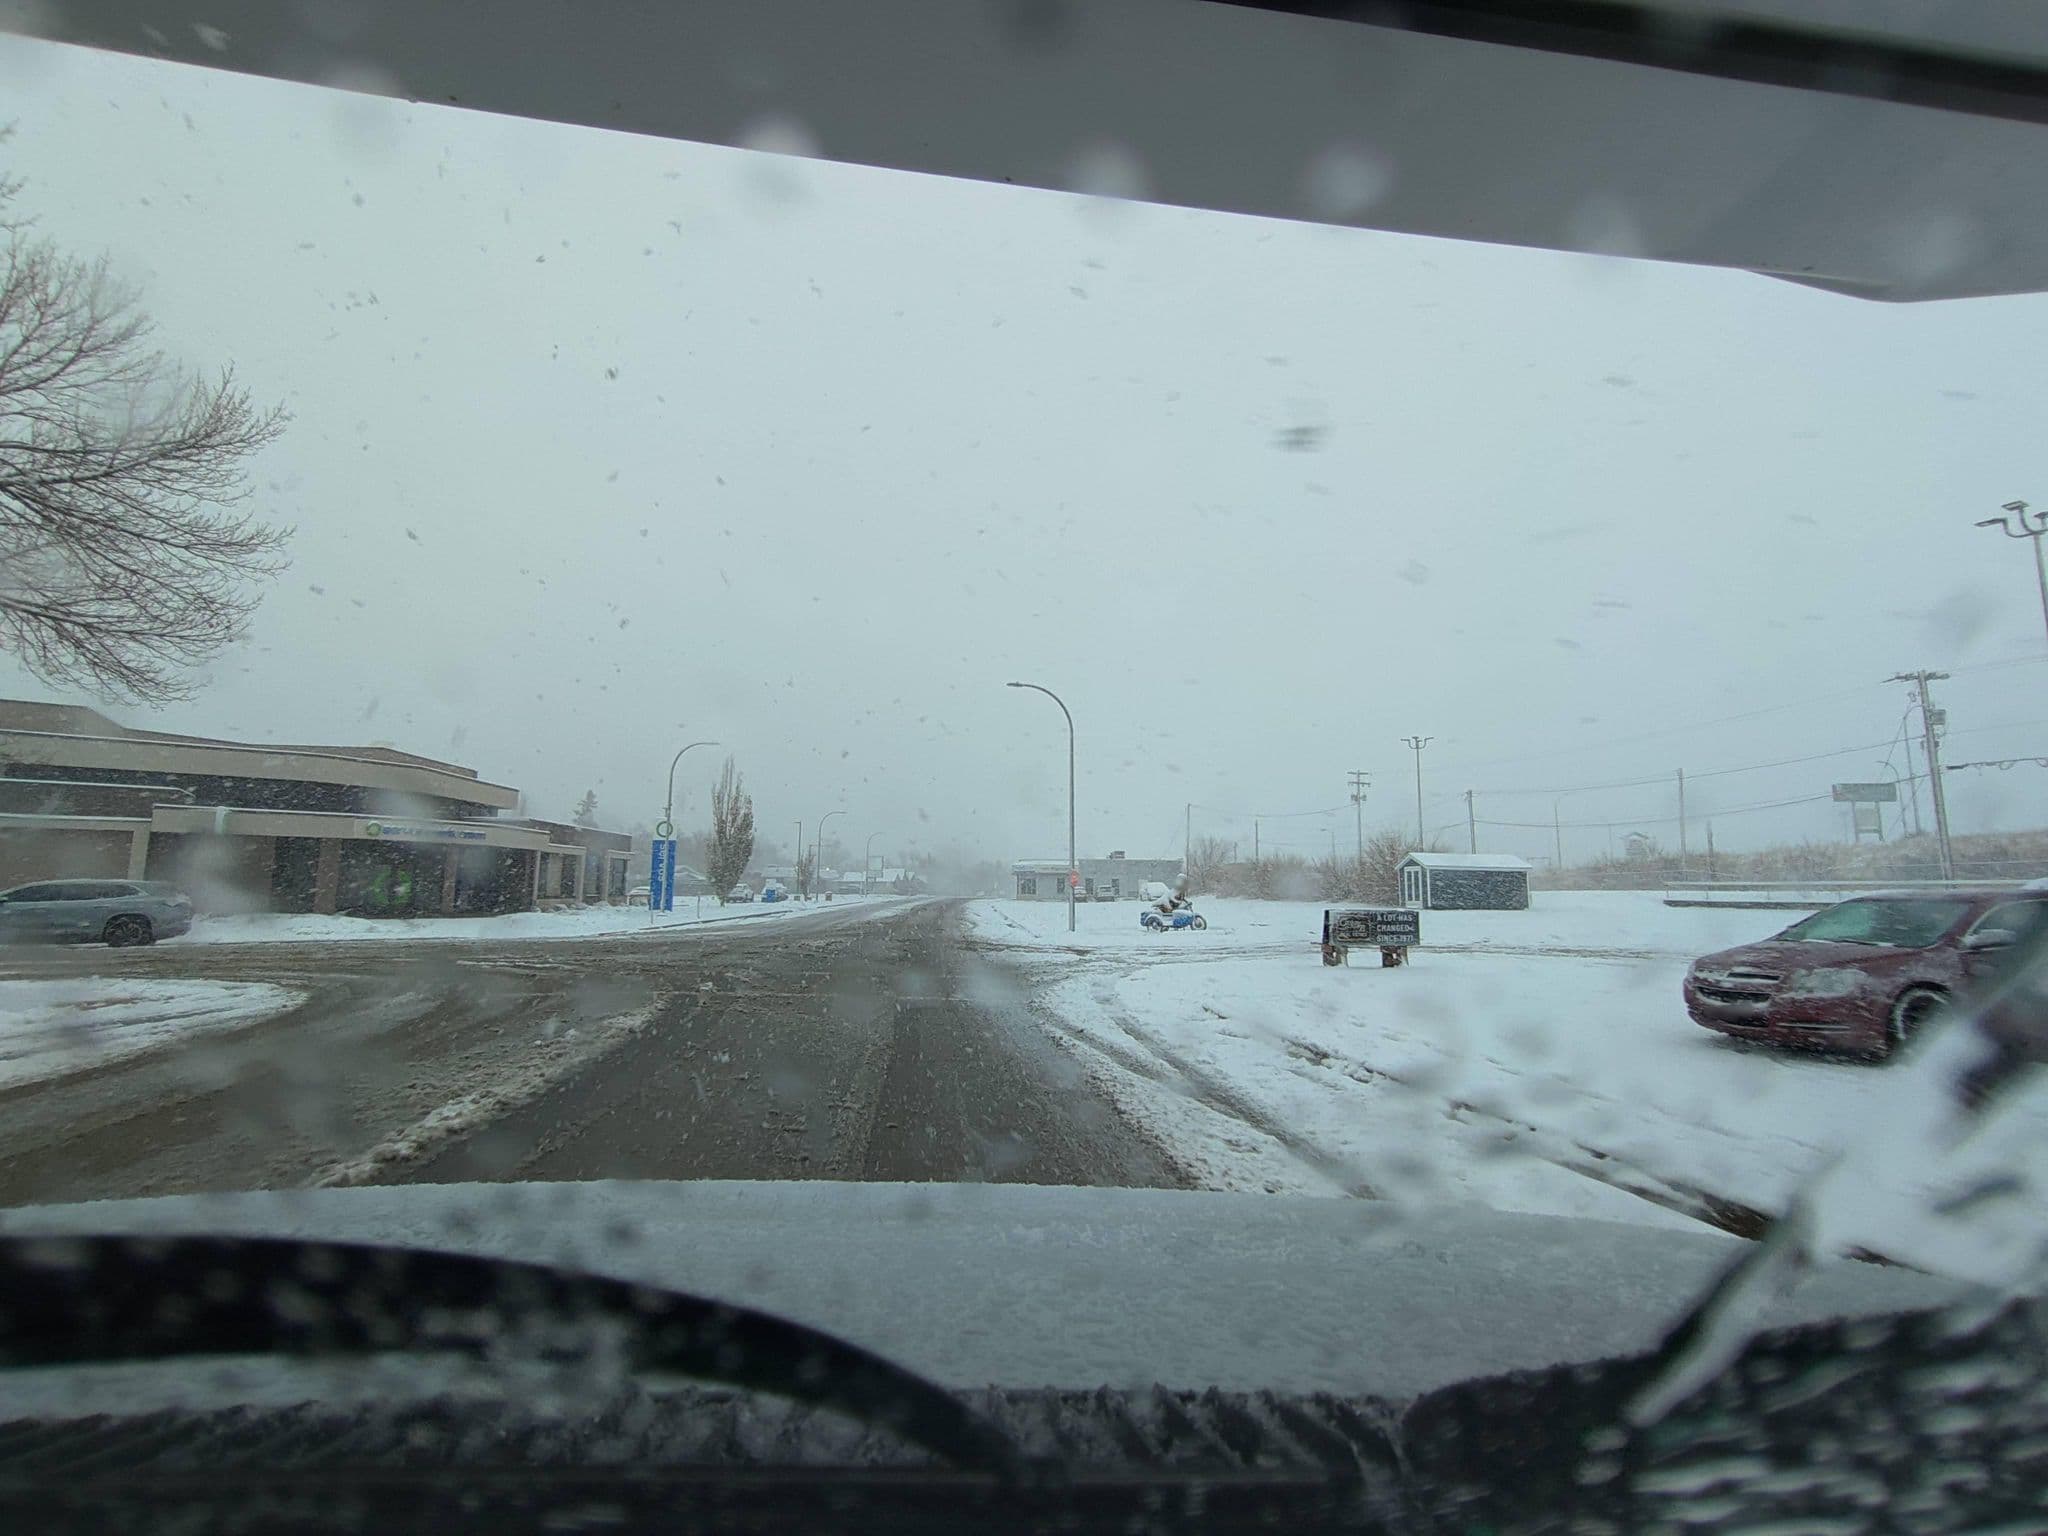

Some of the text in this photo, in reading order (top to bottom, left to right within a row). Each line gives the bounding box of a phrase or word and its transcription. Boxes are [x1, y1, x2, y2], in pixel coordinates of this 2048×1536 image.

[1398, 914, 1413, 922] HAS
[1376, 924, 1410, 932] CHANGED
[1376, 934, 1398, 942] SINCE
